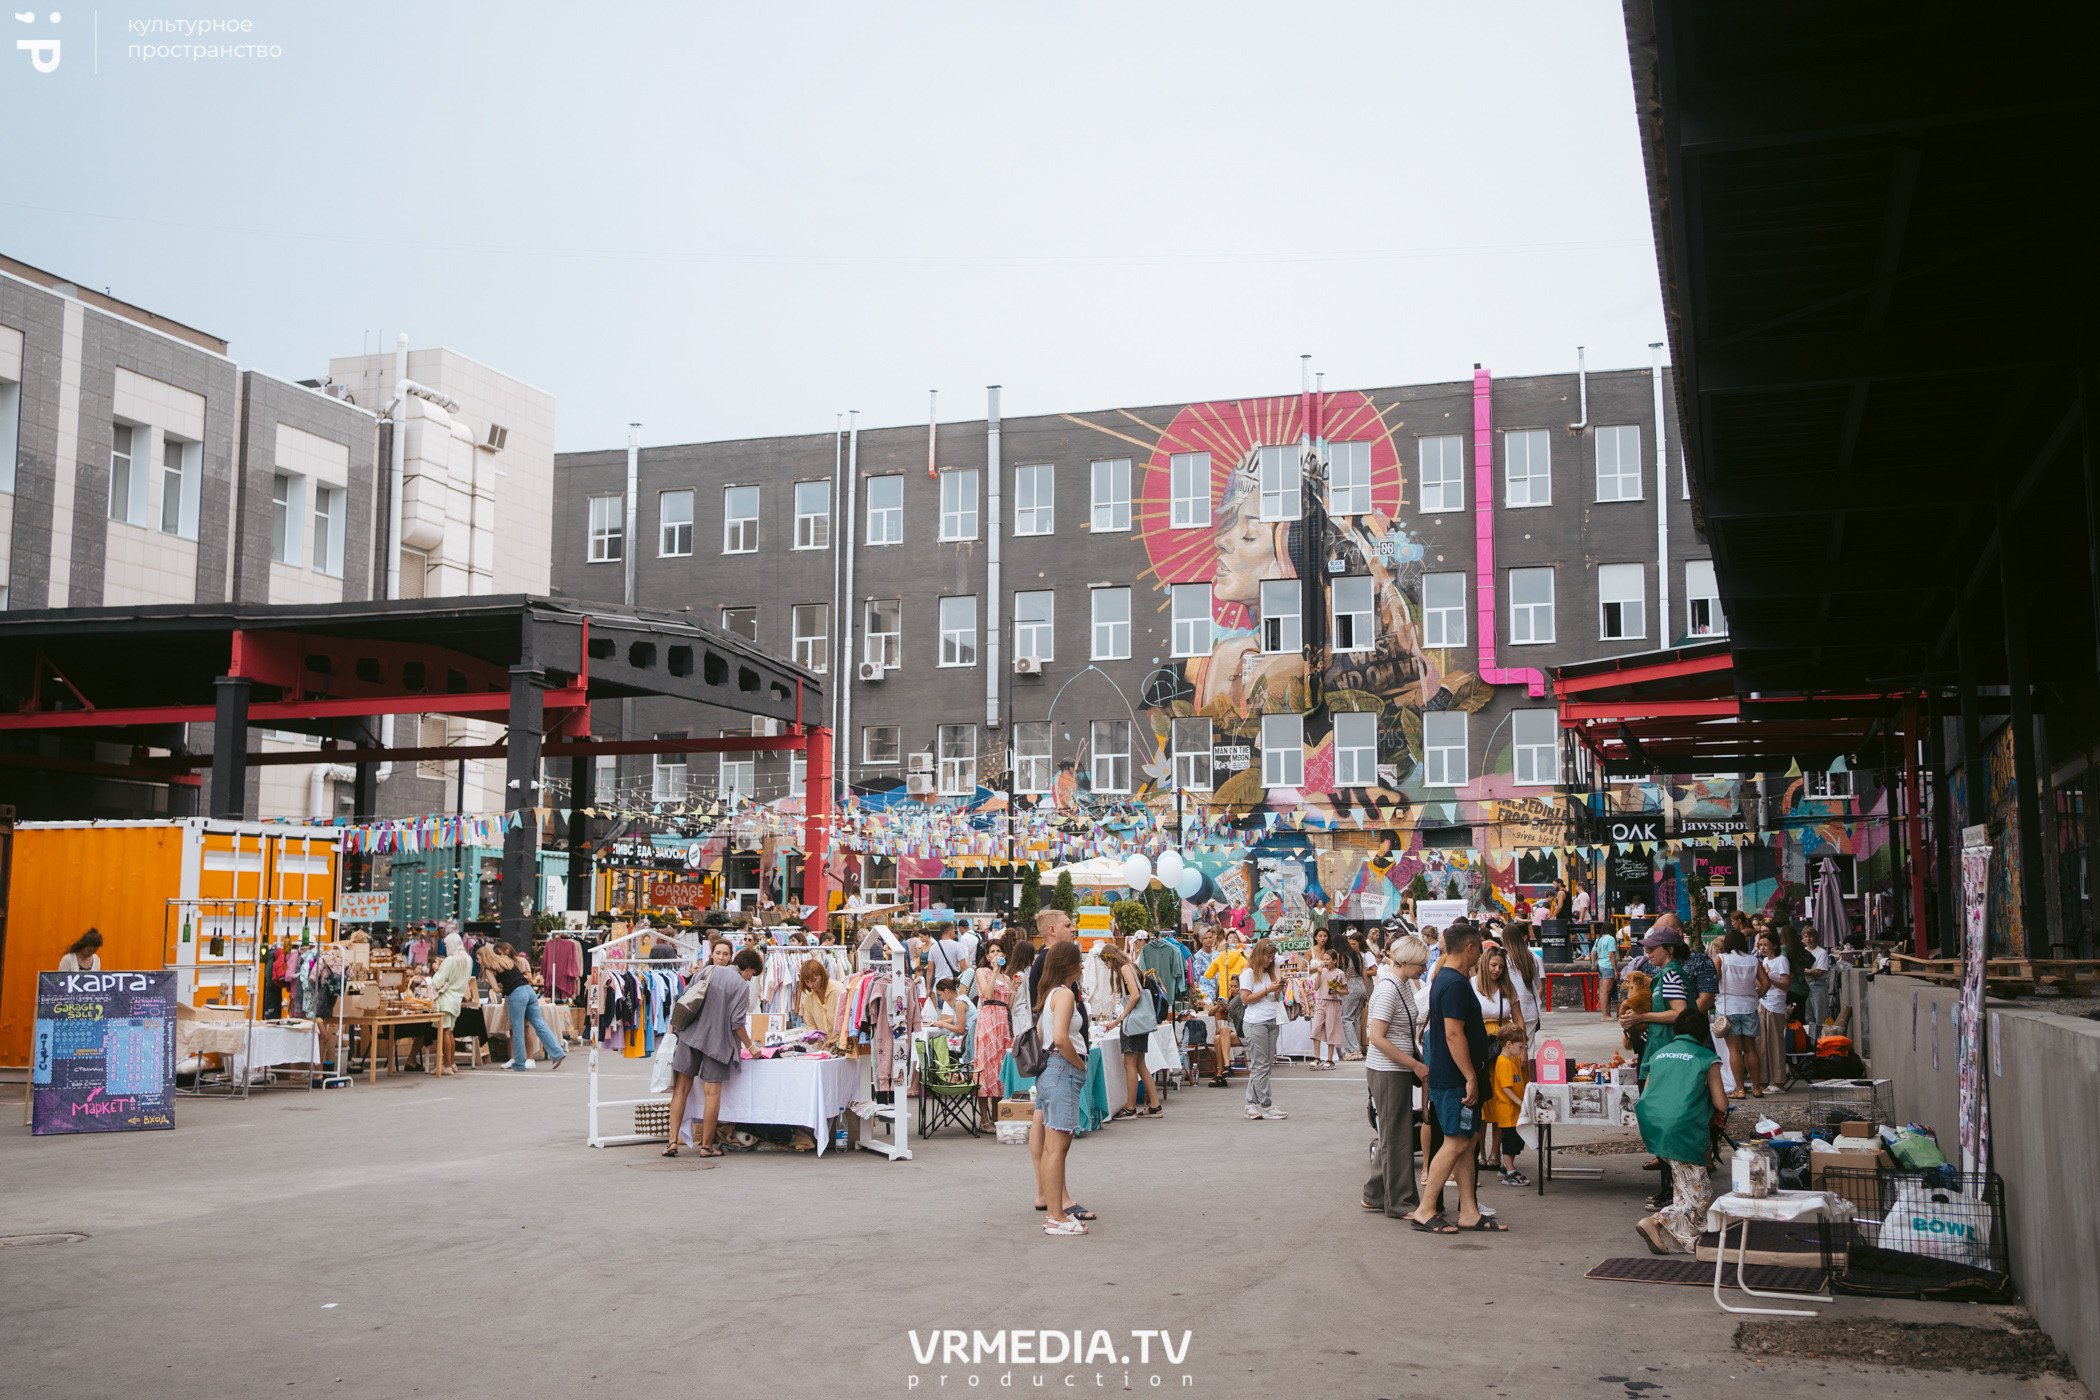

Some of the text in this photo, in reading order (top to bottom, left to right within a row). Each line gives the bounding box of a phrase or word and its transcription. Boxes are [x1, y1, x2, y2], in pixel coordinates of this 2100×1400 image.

[1239, 746, 1249, 754] THE
[1613, 823, 1658, 840] OAK
[1515, 831, 1560, 846] gives birth
[636, 845, 652, 858] ЕДА
[655, 884, 704, 898] GARAGE
[1284, 941, 1311, 950] FOSIKO
